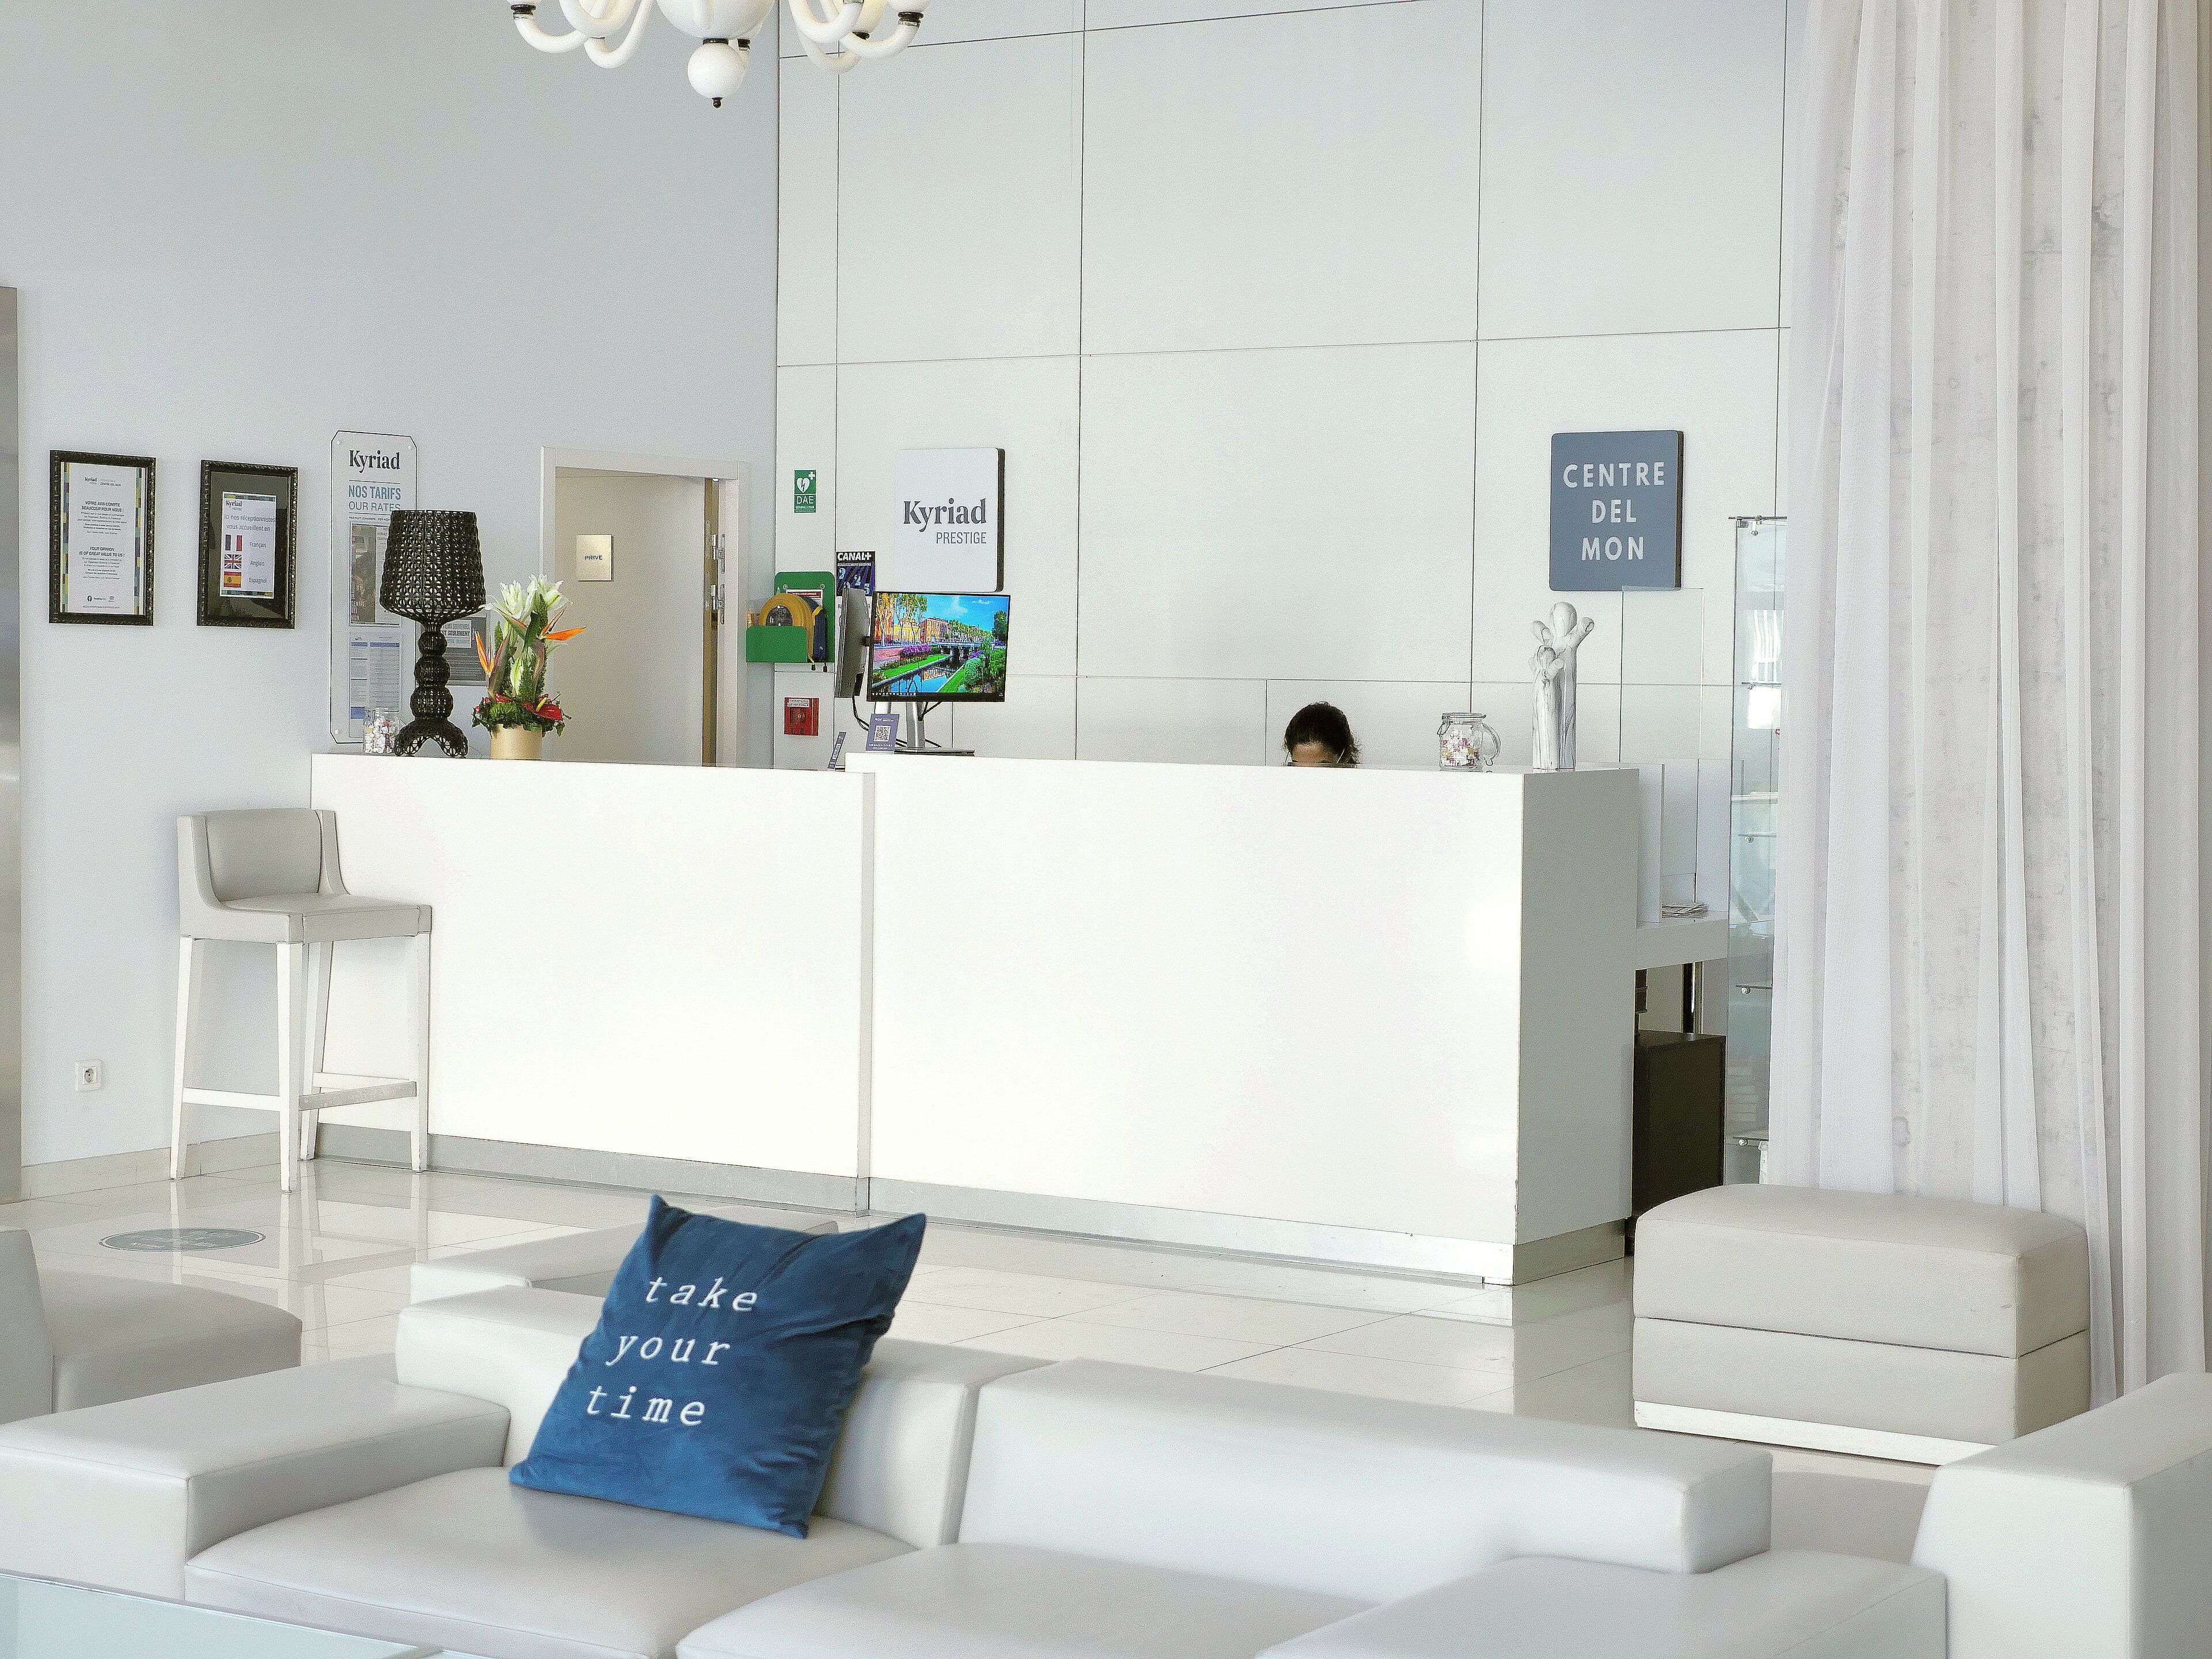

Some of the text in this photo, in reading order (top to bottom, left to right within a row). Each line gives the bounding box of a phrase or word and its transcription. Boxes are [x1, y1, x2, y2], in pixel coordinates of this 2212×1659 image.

[349, 450, 400, 474] Kyriad
[1562, 461, 1665, 488] CENTRE
[226, 500, 243, 508] Kyriad
[349, 485, 401, 501] NOS TARIFS
[797, 496, 814, 504] DAE
[240, 514, 275, 522] réceptionnistes
[349, 501, 401, 512] OUR RATES
[903, 497, 987, 532] Kyriad
[1592, 499, 1637, 524] DEL
[935, 532, 987, 544] PRESTIGE
[1581, 536, 1644, 561] MON
[837, 552, 872, 561] CANAL+
[645, 1275, 758, 1312] take
[604, 1335, 732, 1367] your
[586, 1385, 706, 1426] time
